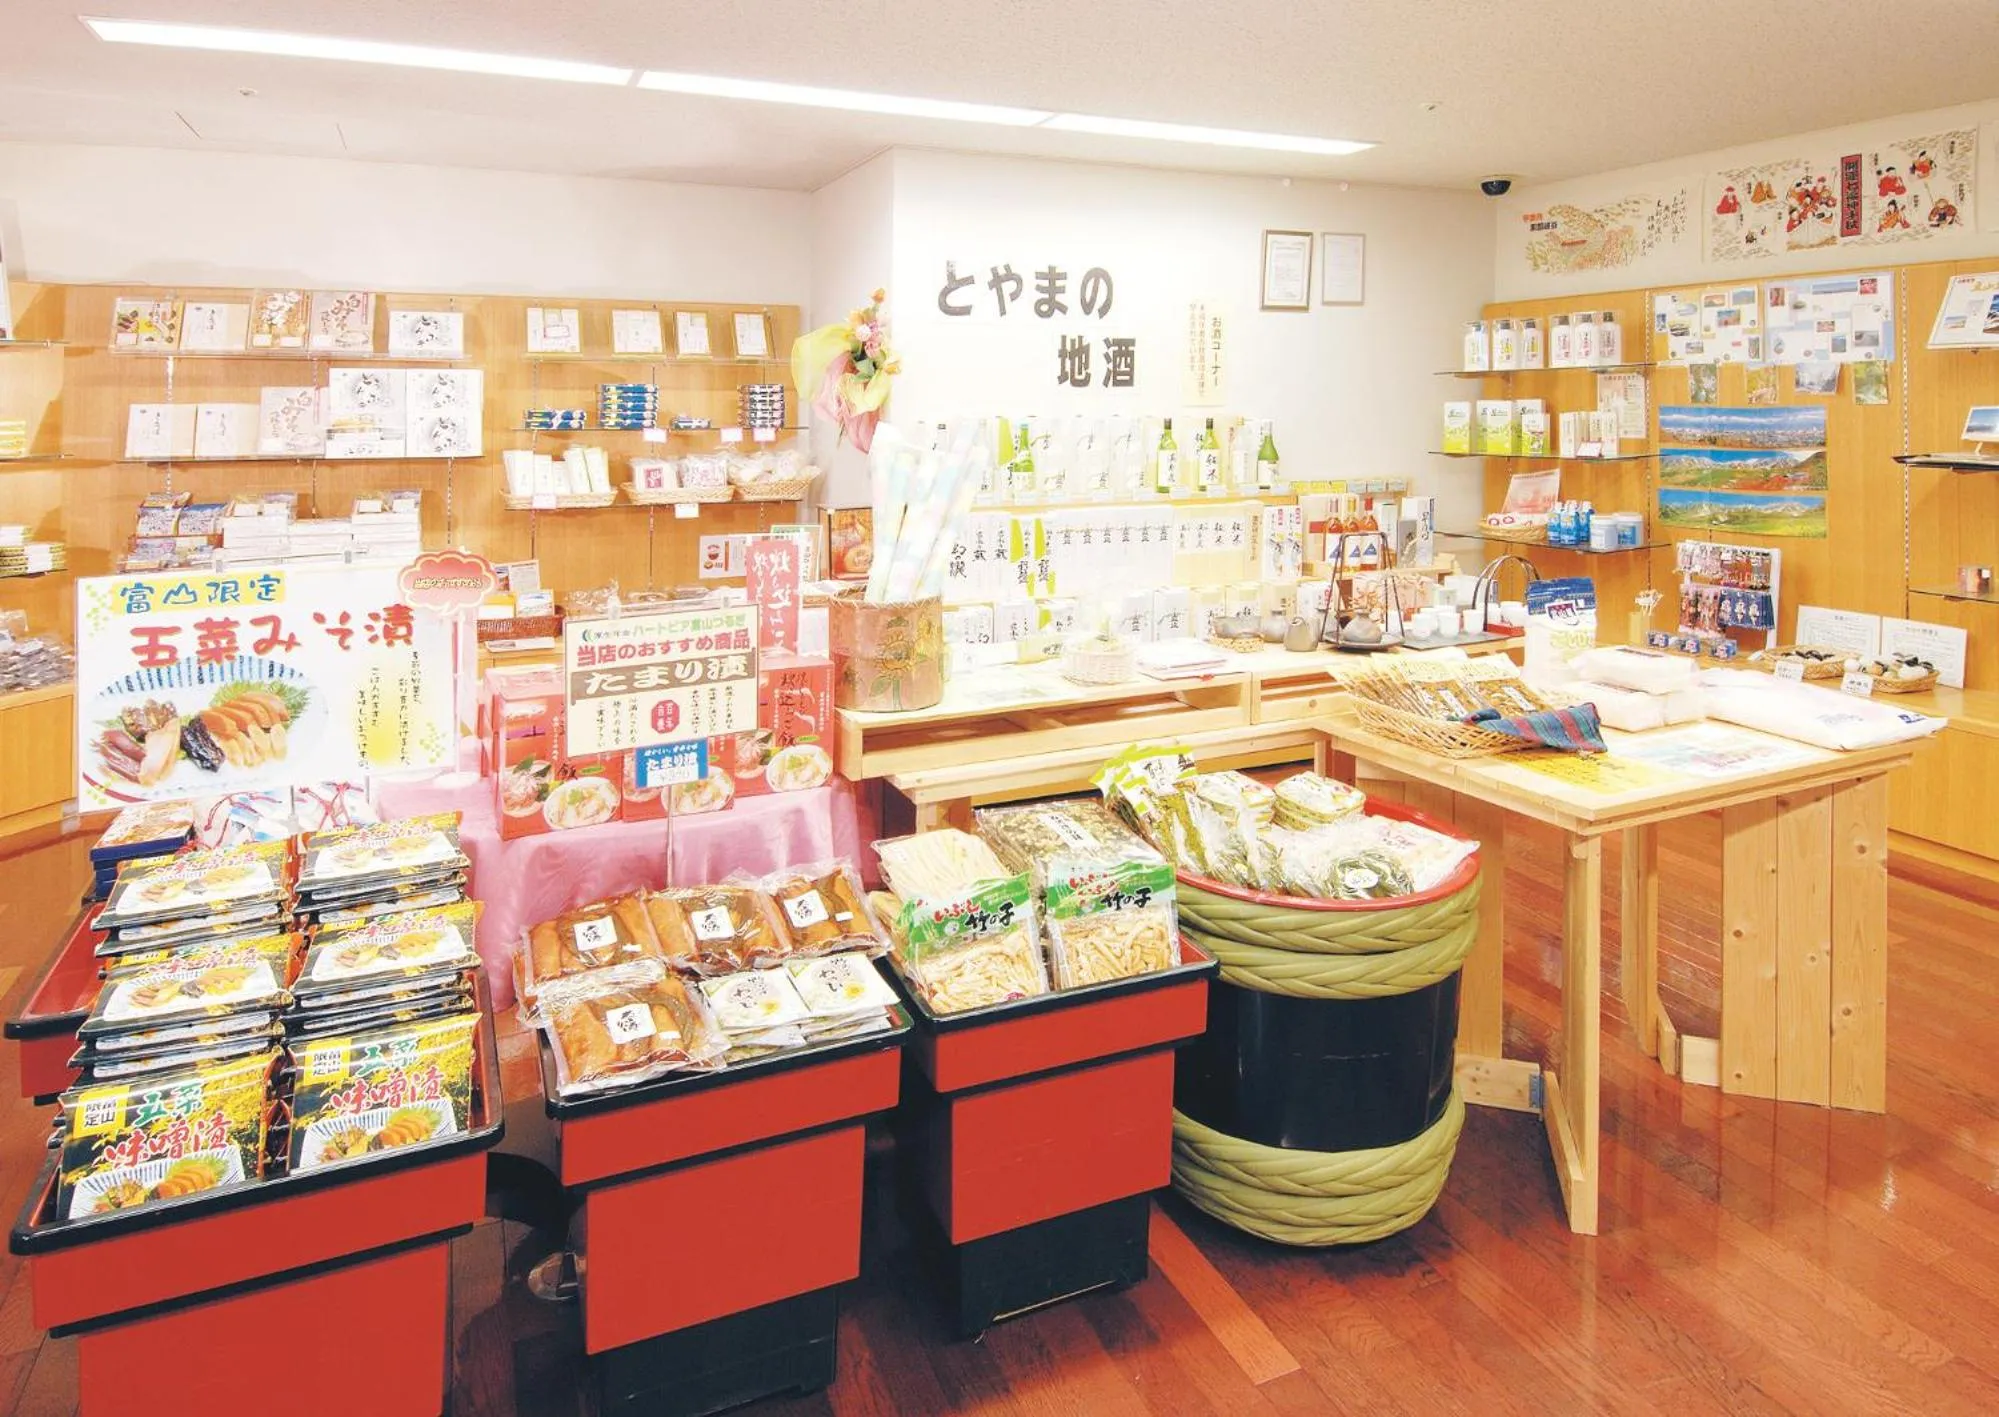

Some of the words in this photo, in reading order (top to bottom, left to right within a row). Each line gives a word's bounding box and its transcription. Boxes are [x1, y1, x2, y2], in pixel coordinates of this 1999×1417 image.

[938, 260, 1114, 320] とやまの
[1057, 334, 1136, 388] 地酒
[1210, 316, 1222, 388] お酒コーナー
[119, 574, 282, 614] 富山限定
[130, 603, 414, 669] 五菜みそ漬
[576, 628, 751, 667] 当店のおすすめ商品
[584, 655, 748, 695] たまり漬
[964, 901, 1015, 932] 竹の子
[1101, 886, 1152, 911] 竹の子
[132, 1084, 203, 1127] 五菜
[330, 1065, 443, 1115] 味噌漬
[104, 1111, 232, 1169] 味噌漬
